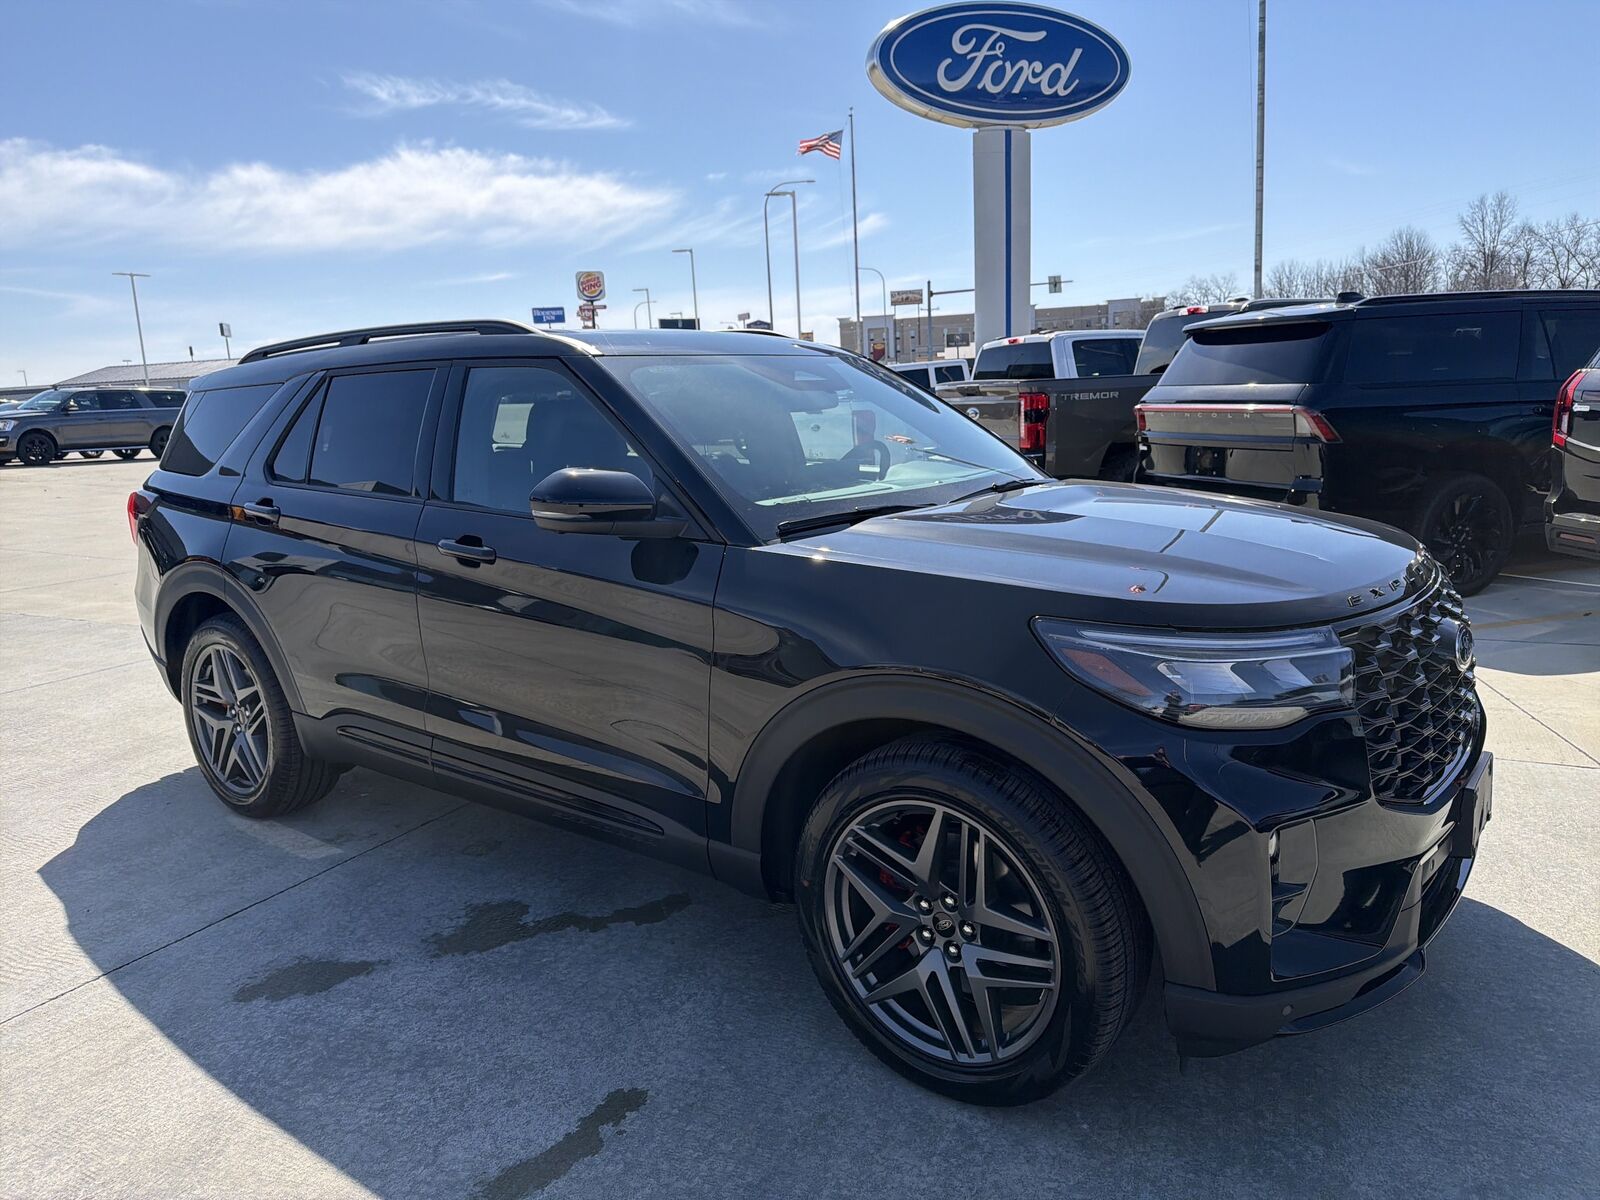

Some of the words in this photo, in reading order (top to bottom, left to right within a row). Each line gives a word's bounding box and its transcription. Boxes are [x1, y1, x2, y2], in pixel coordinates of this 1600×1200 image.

[937, 24, 1082, 96] Ford
[582, 281, 602, 292] KING
[1061, 391, 1120, 401] TREMOR
[968, 796, 1071, 907] SCORPION
